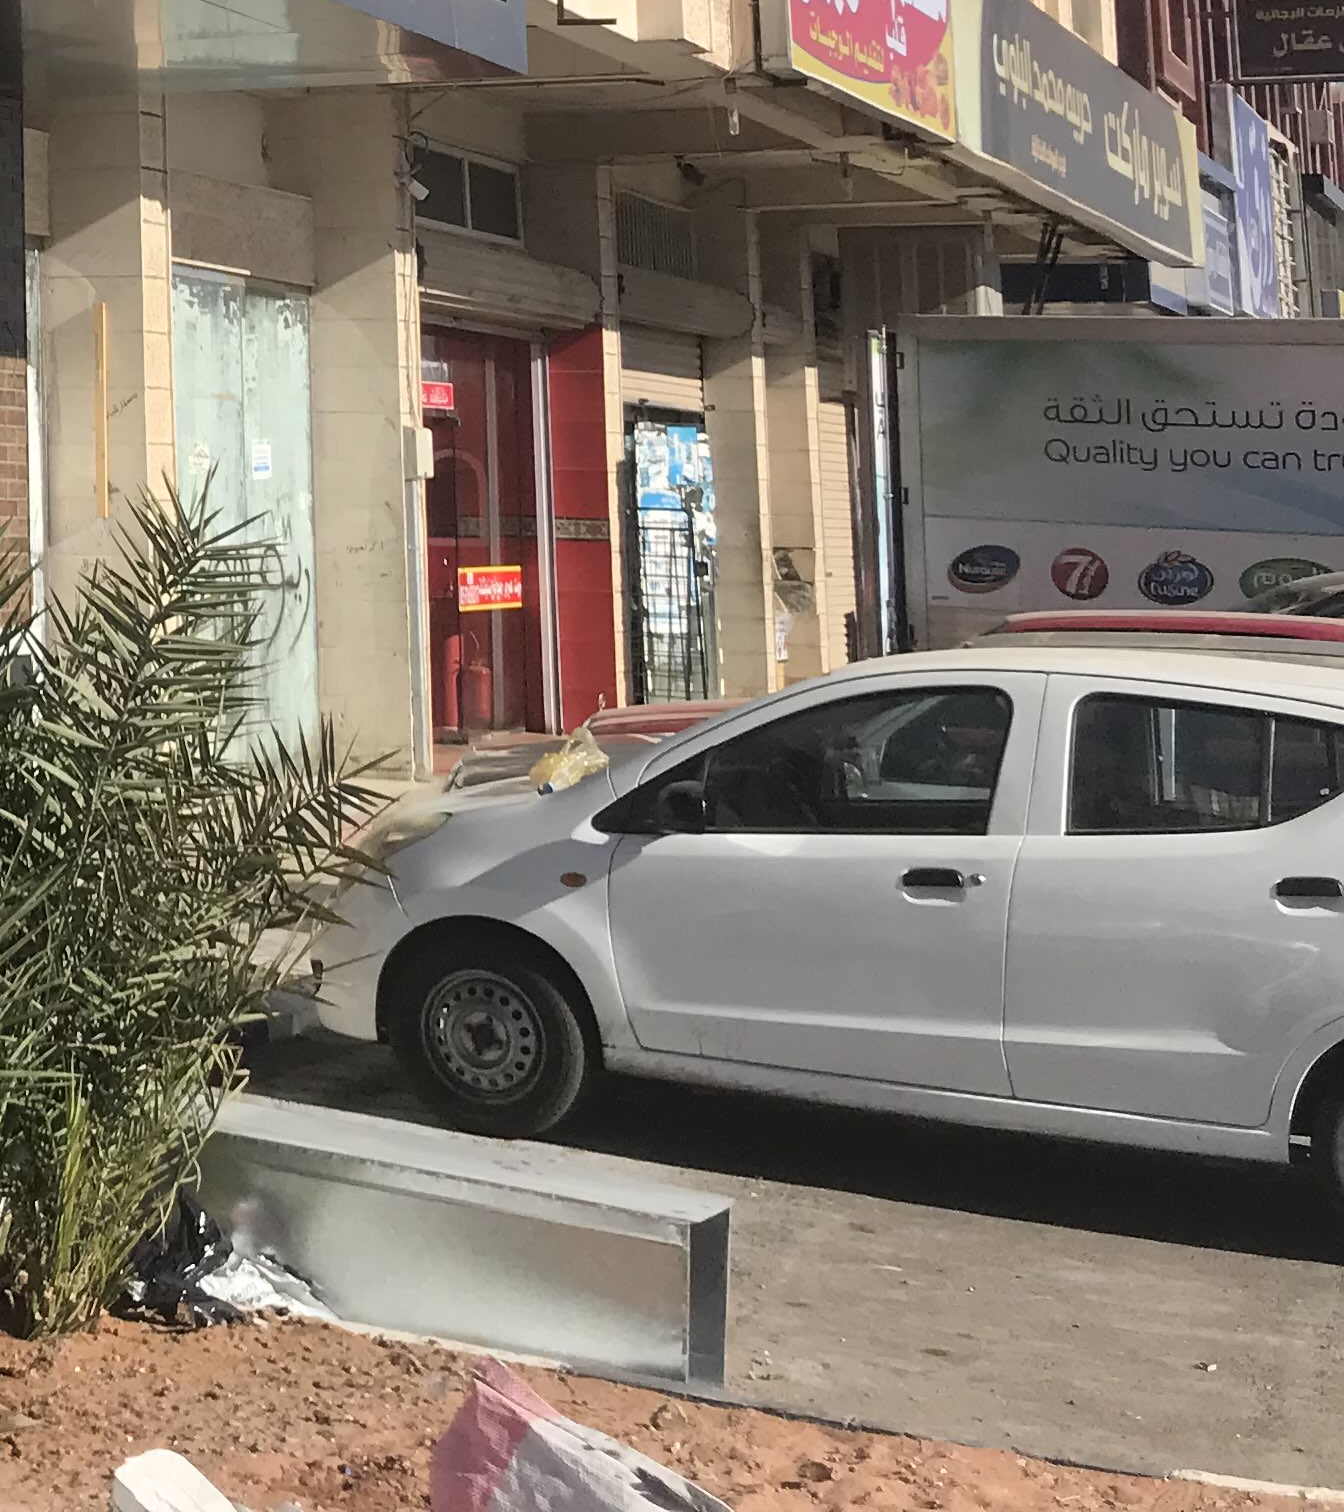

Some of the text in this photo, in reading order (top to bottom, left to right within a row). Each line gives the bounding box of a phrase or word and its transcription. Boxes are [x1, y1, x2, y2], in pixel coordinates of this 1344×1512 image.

[1043, 394, 1131, 425] الثقة
[1141, 399, 1283, 432] تستحق
[1044, 439, 1158, 471] Quality
[1169, 448, 1231, 472] you
[1243, 451, 1302, 471] can
